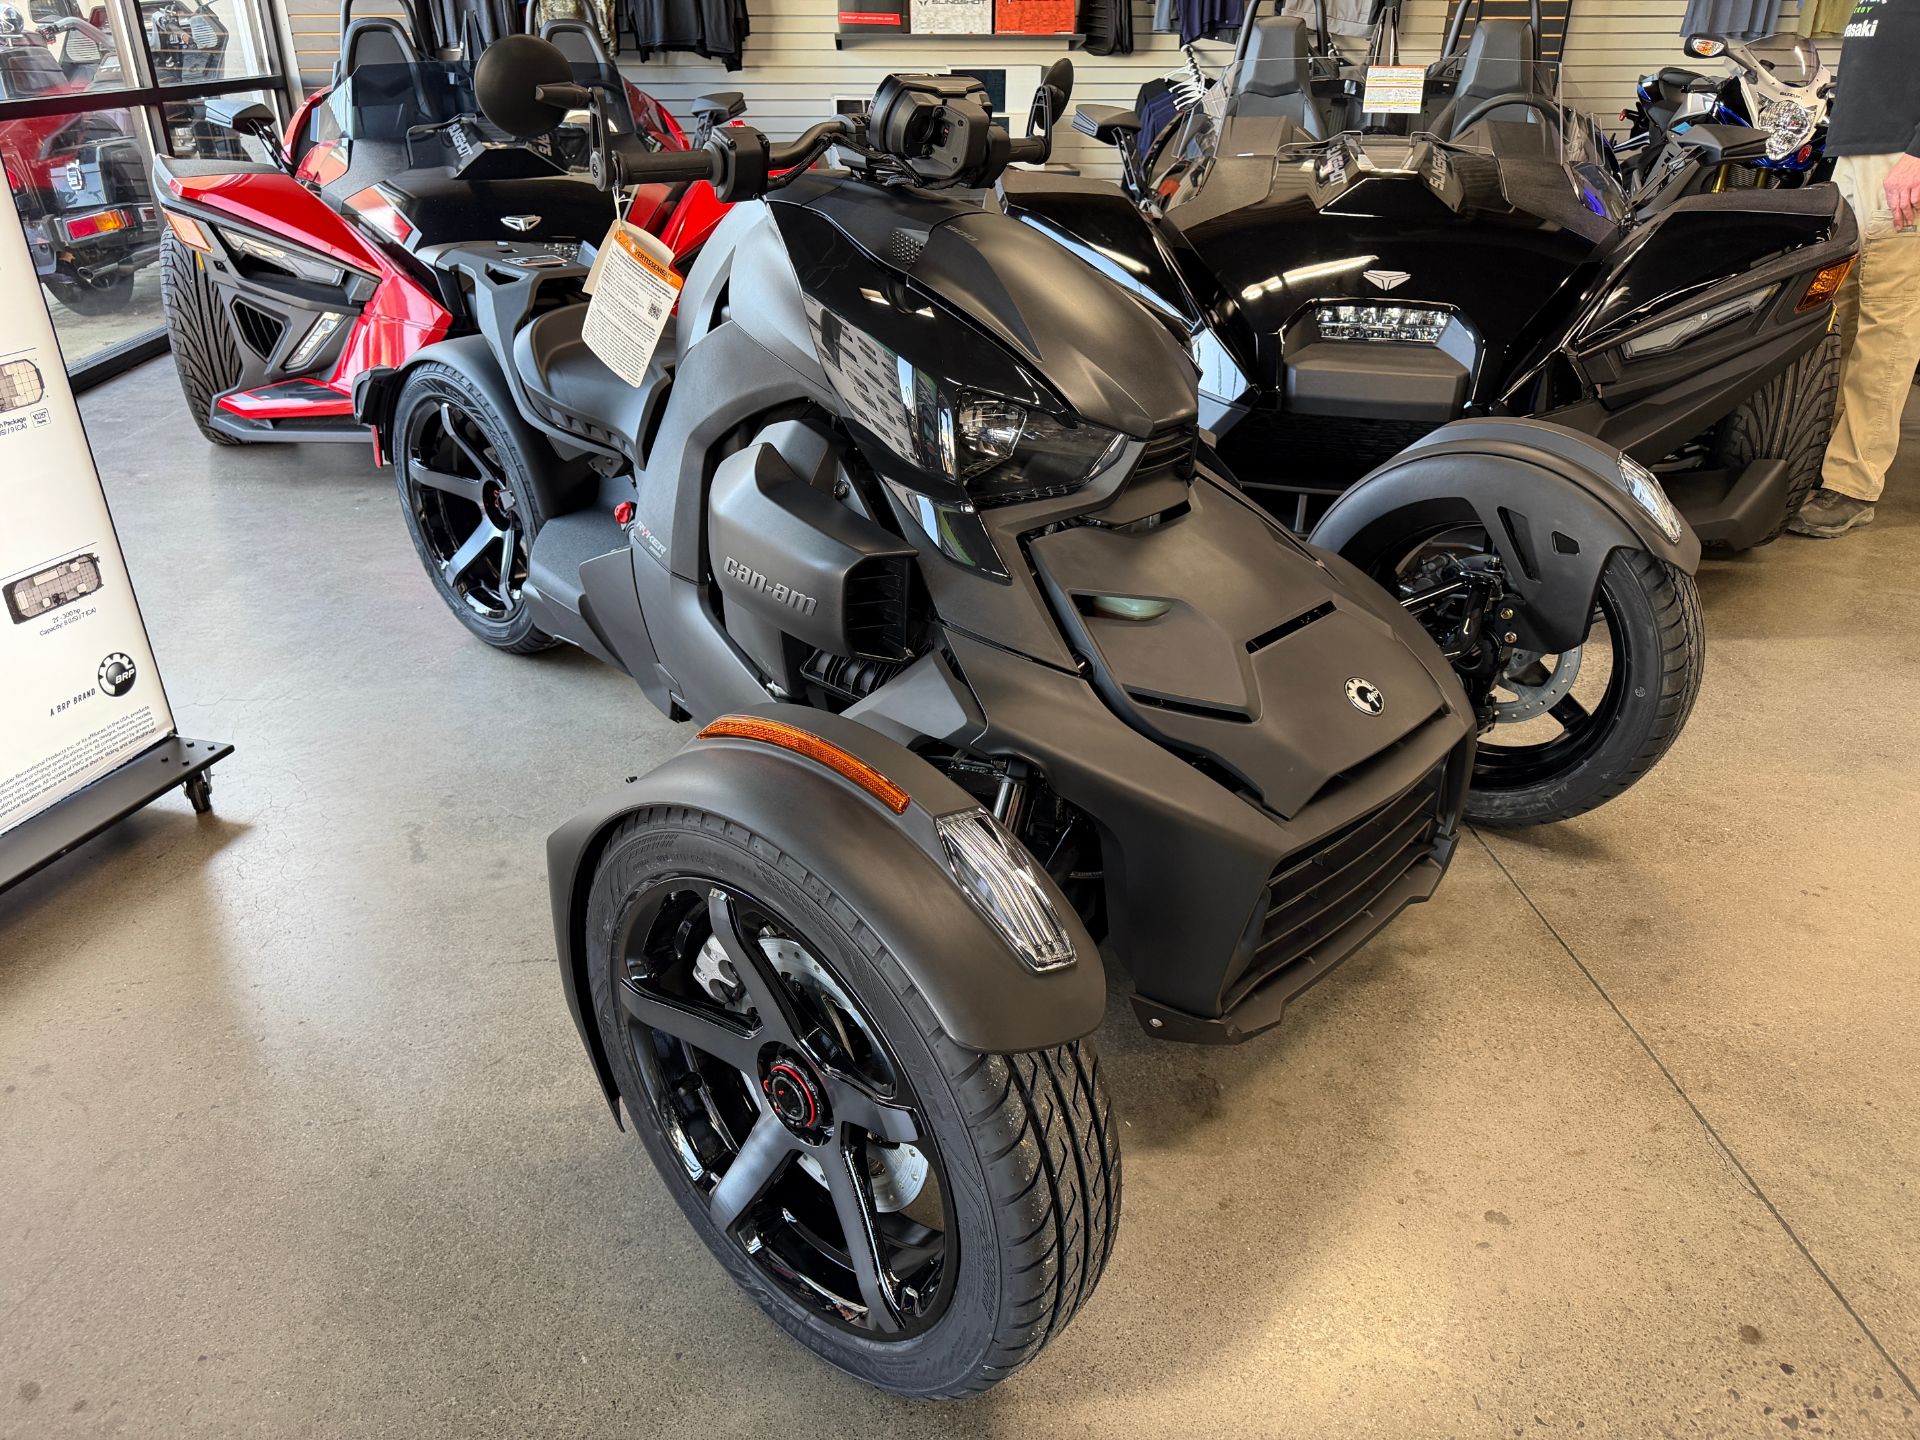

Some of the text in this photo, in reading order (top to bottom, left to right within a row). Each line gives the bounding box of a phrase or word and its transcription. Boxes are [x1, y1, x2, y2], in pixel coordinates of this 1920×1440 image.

[1844, 20, 1878, 37] asaki
[636, 520, 667, 554] RYKER
[724, 556, 818, 616] can-am
[116, 668, 135, 684] BRP
[50, 688, 96, 717] A BRP BRAND
[16, 759, 45, 778] Recreational
[46, 748, 67, 762] Products
